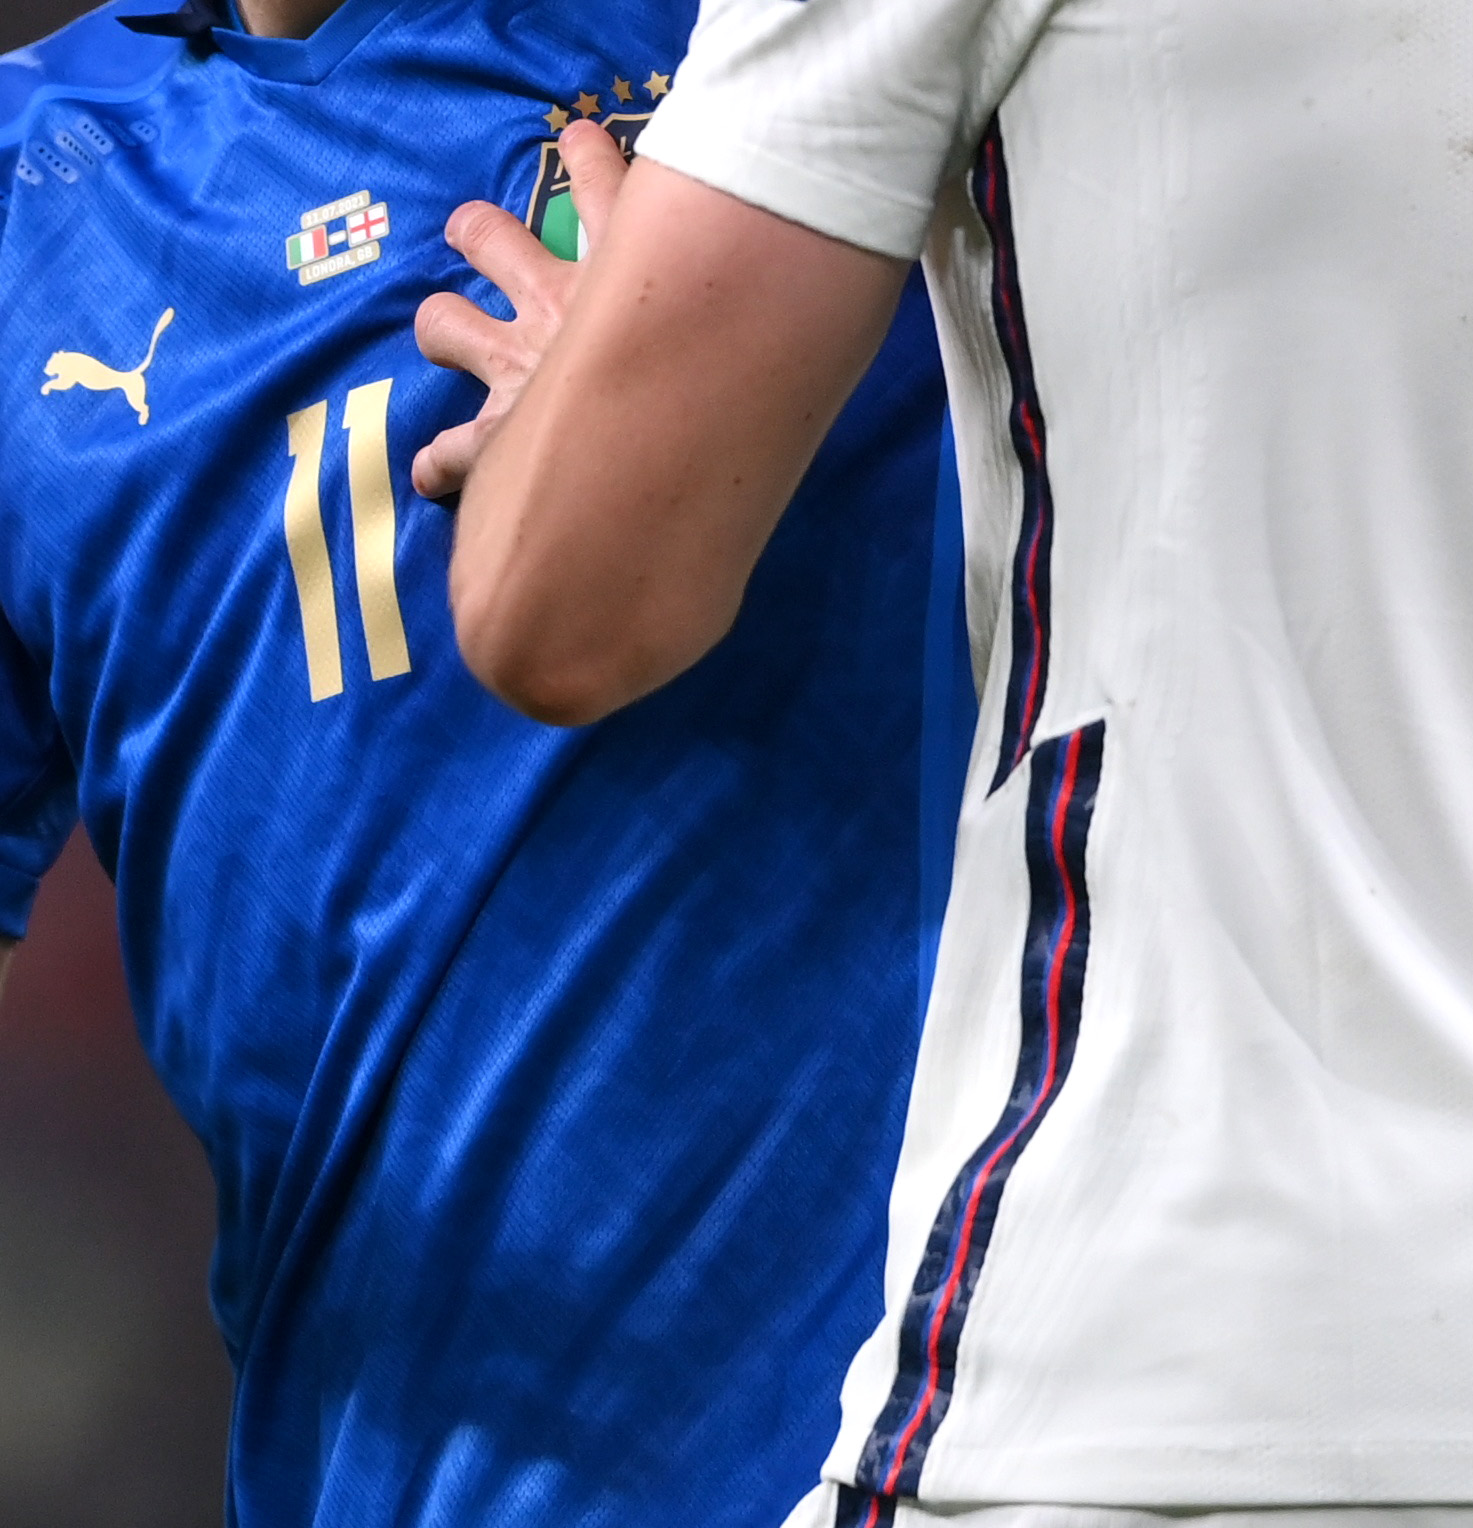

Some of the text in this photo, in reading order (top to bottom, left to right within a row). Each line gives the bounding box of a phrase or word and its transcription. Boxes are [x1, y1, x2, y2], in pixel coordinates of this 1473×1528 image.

[303, 194, 365, 225] 11.07.2021
[304, 253, 356, 281] LONDRA,
[284, 378, 412, 704] 11
